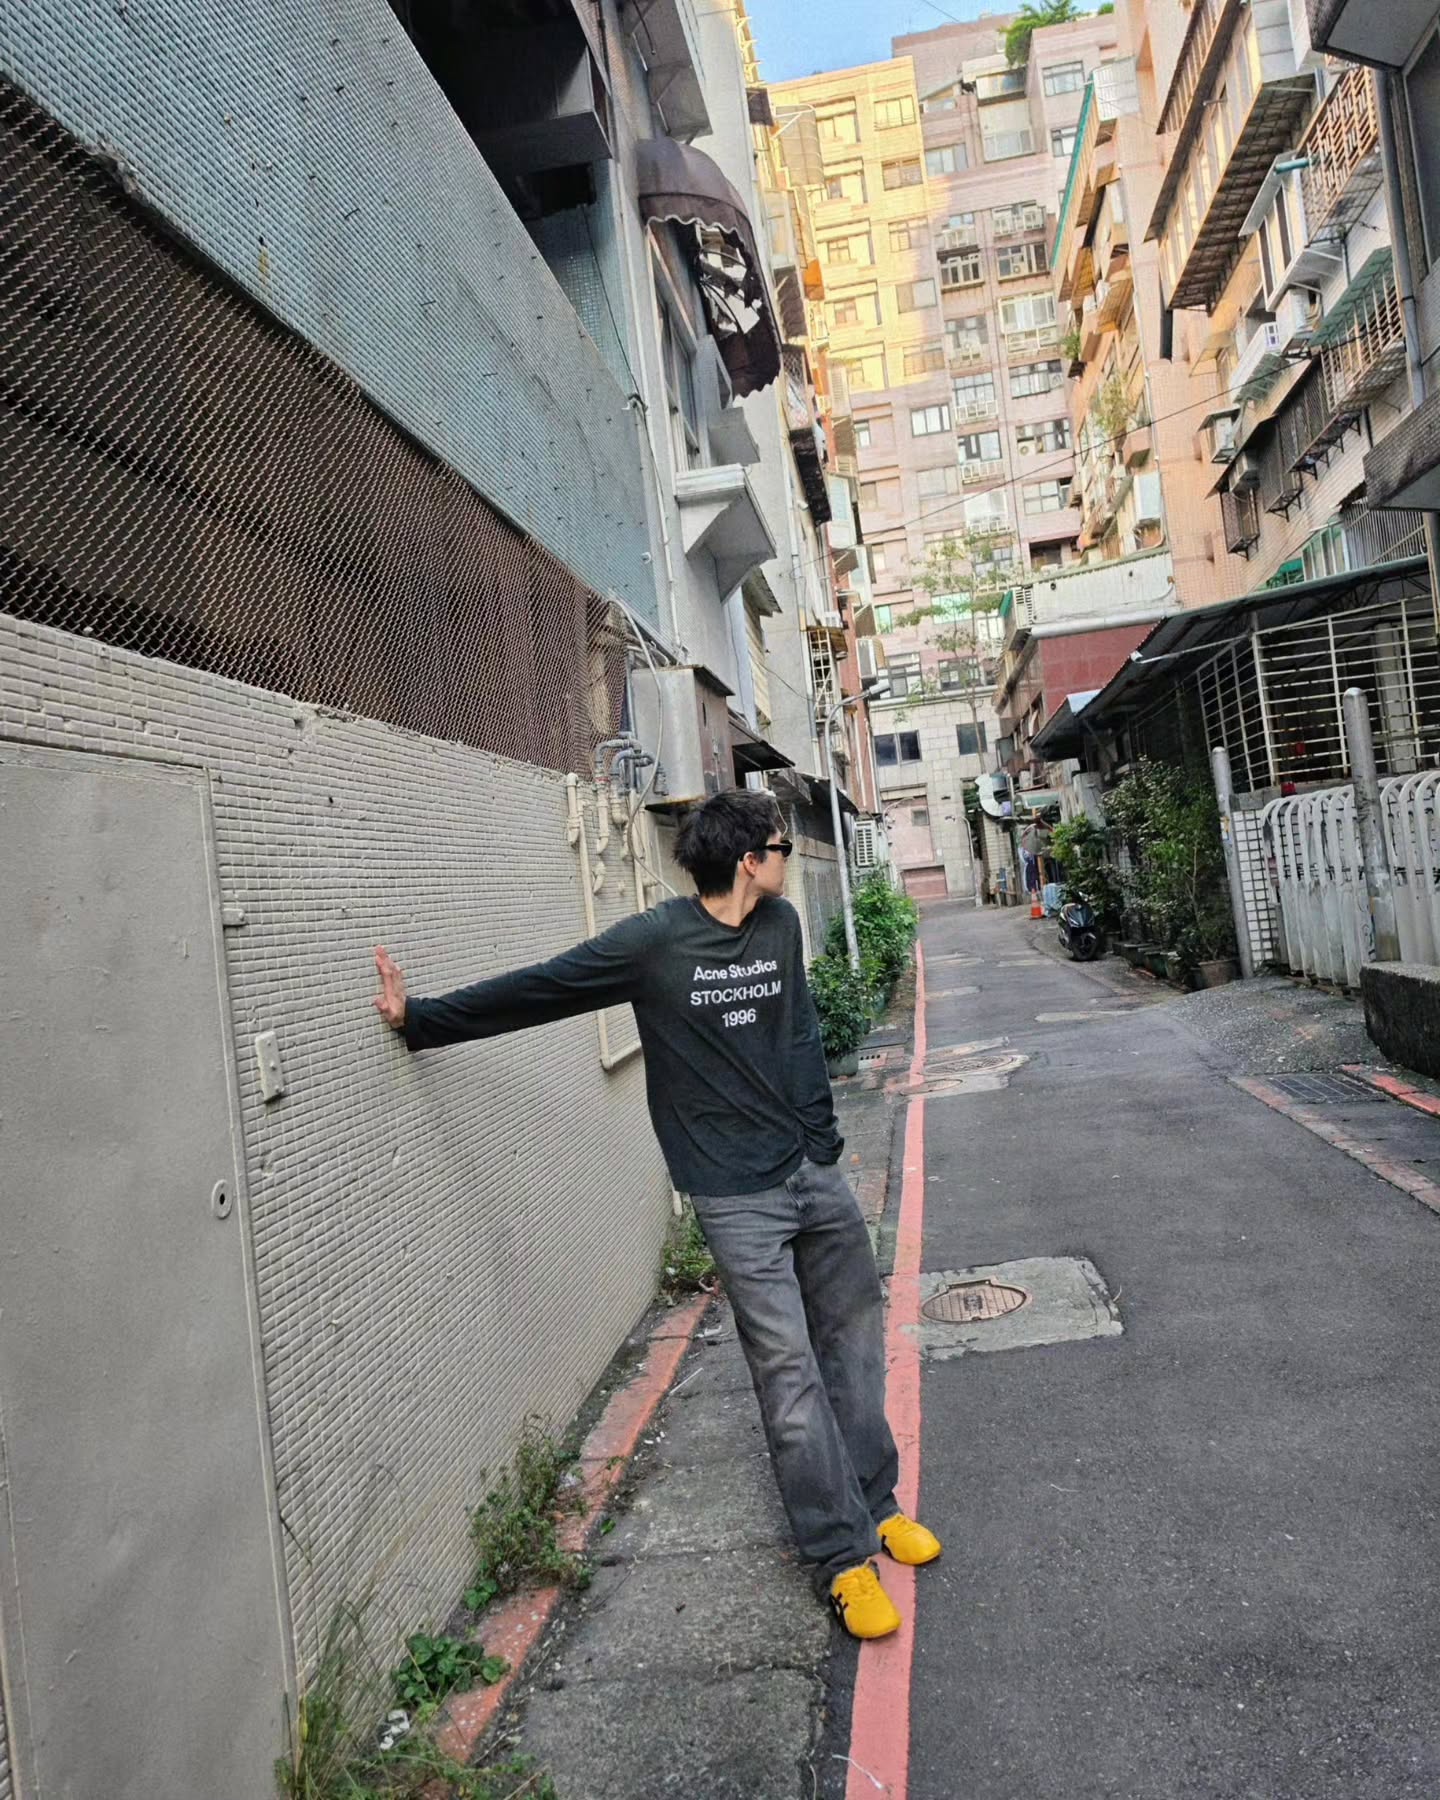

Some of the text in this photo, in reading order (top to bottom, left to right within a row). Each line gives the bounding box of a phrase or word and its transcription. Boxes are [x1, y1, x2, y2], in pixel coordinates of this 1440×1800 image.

[693, 960, 778, 981] Acne Studios
[690, 980, 782, 1005] STOCKHOLM
[722, 1008, 756, 1027] 1996
